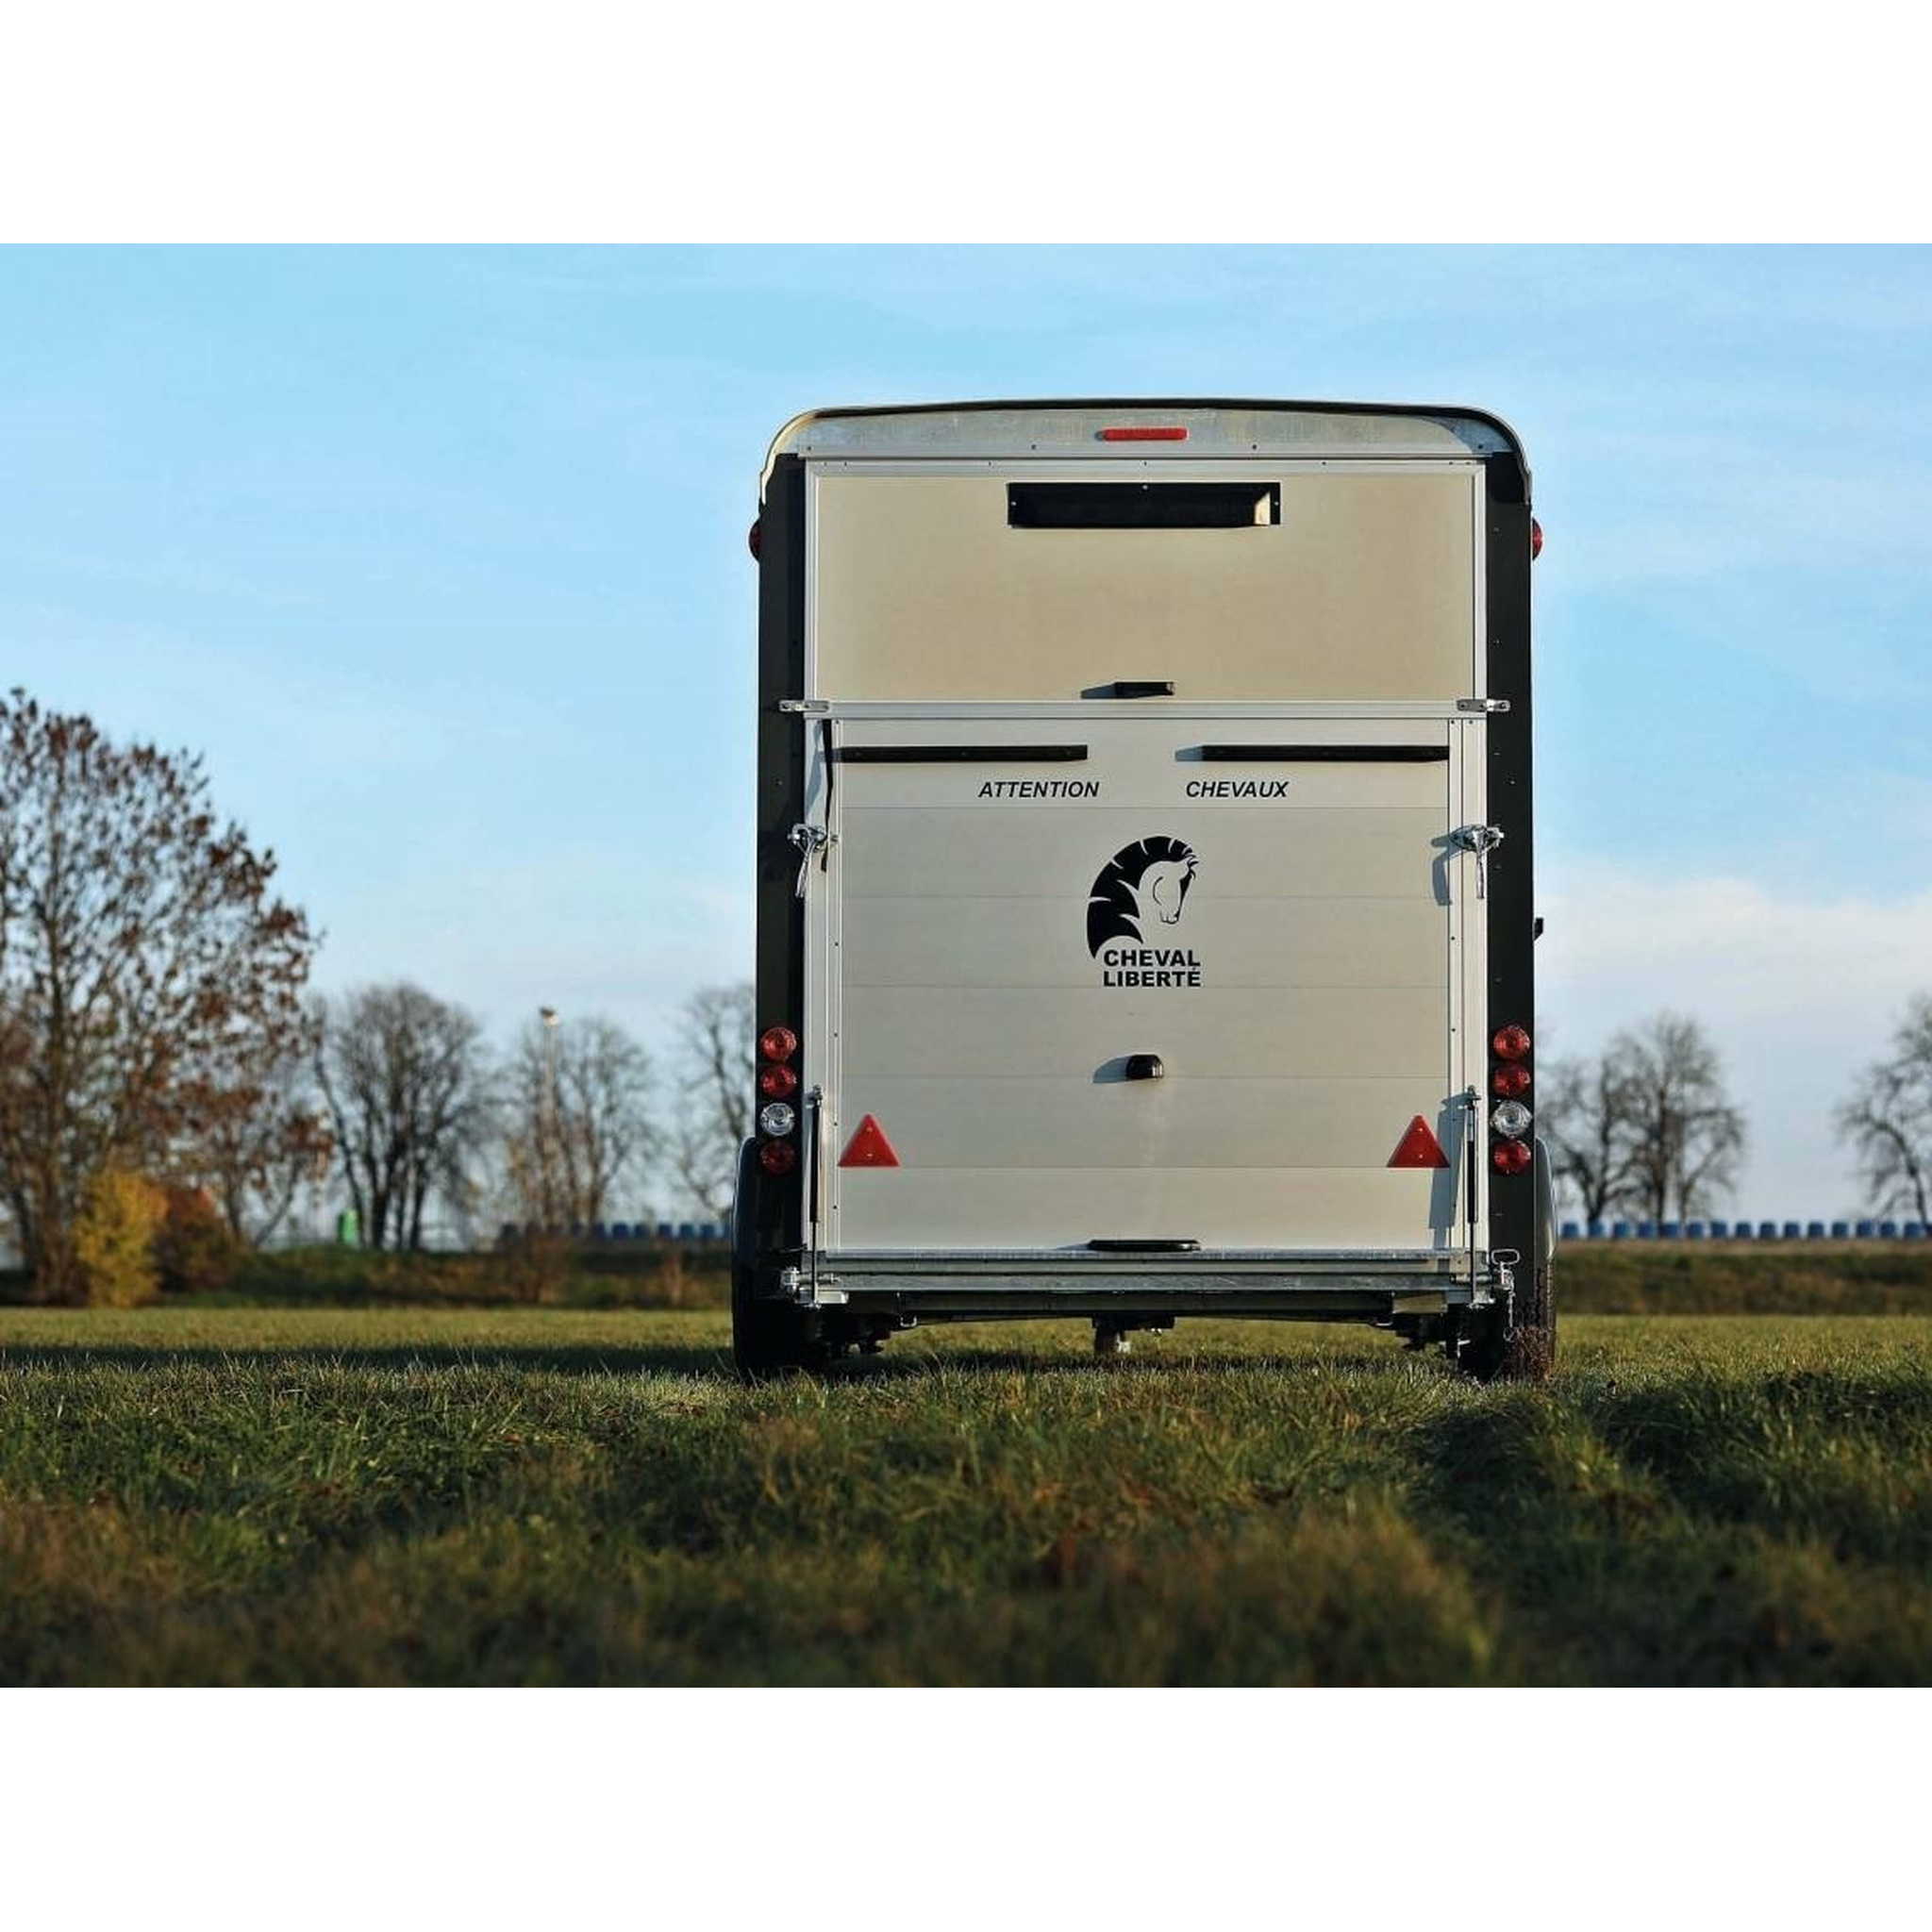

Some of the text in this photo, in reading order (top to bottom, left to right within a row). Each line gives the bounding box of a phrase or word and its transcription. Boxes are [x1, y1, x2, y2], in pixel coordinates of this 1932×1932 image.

[978, 780, 1290, 798] ATTENTION CHEVAUX
[1103, 949, 1201, 967] CHEVAL
[1103, 967, 1201, 988] LIBERTÉ
